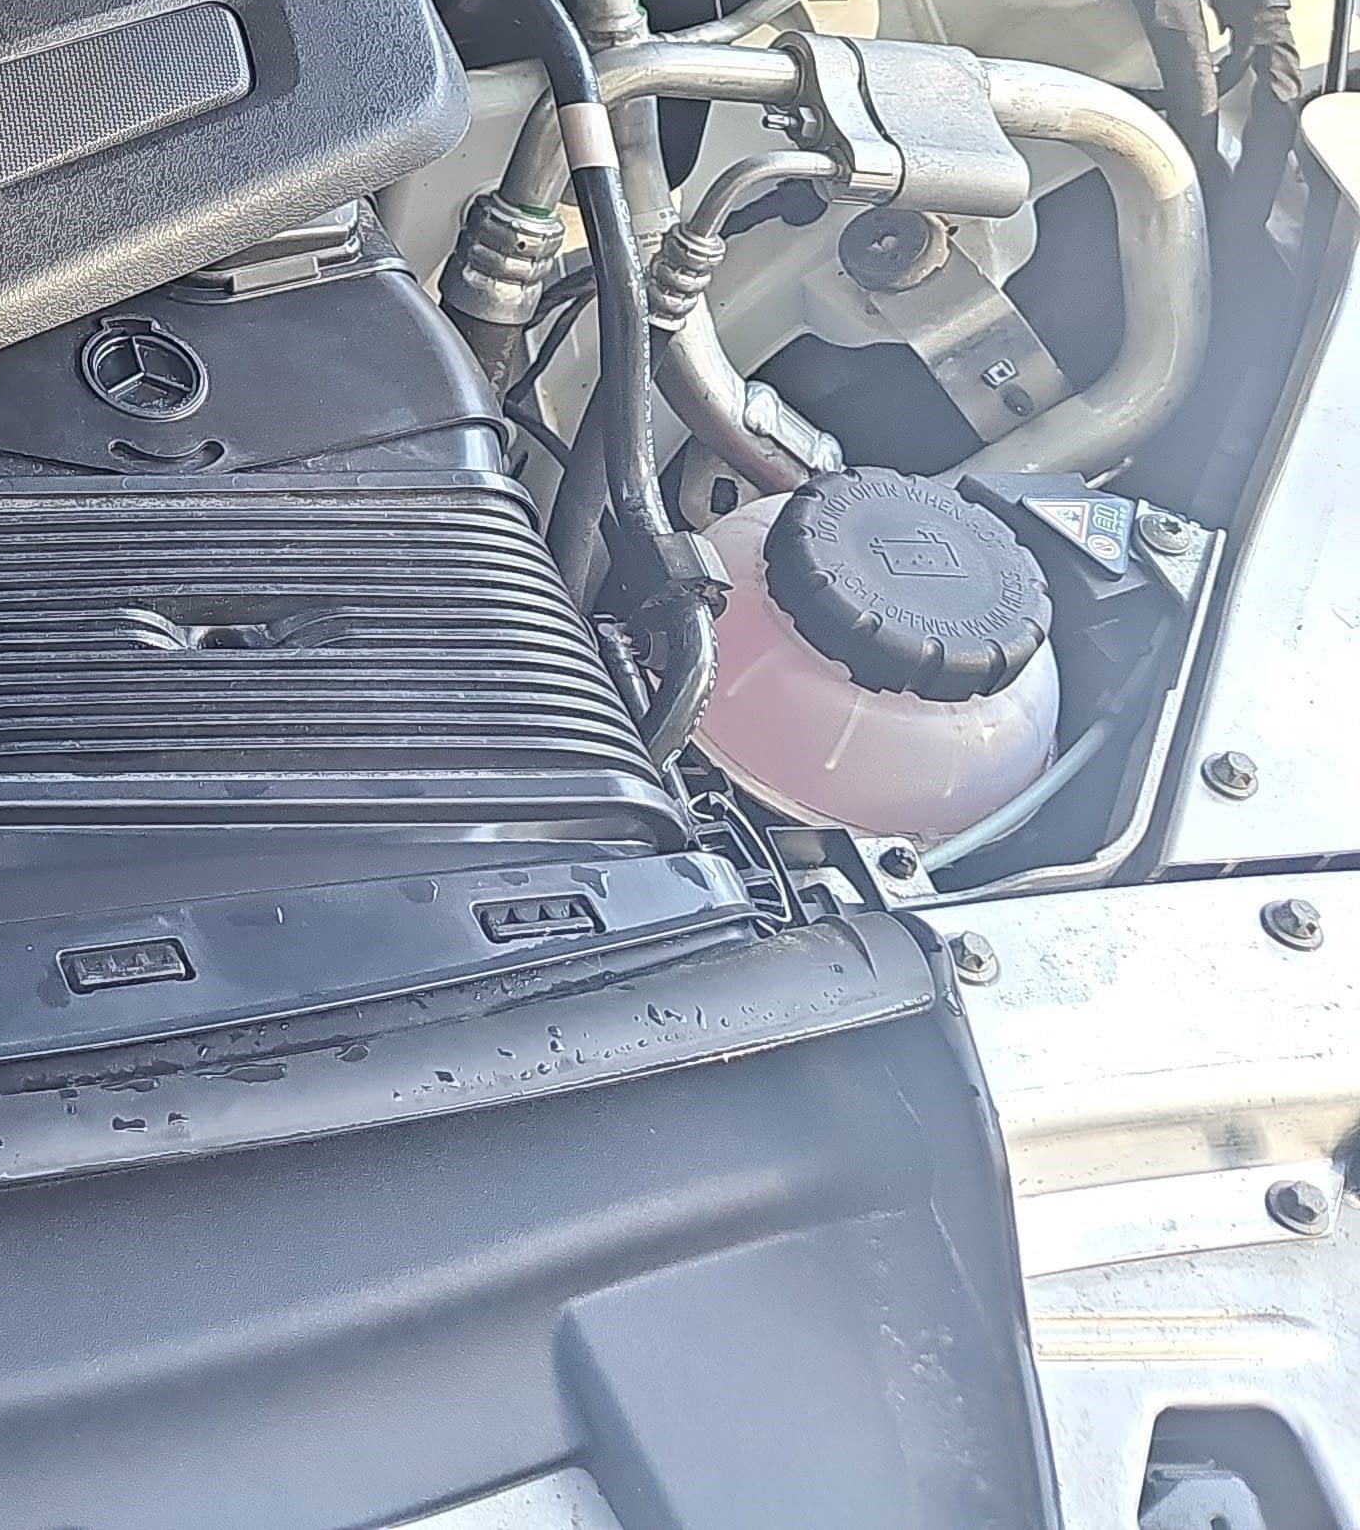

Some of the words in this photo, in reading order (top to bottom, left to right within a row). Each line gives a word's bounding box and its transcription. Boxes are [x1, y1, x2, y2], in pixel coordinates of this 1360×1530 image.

[848, 482, 899, 502] OPEN
[905, 485, 965, 520] WHEN
[821, 495, 853, 522] NOT
[817, 520, 838, 543] DO
